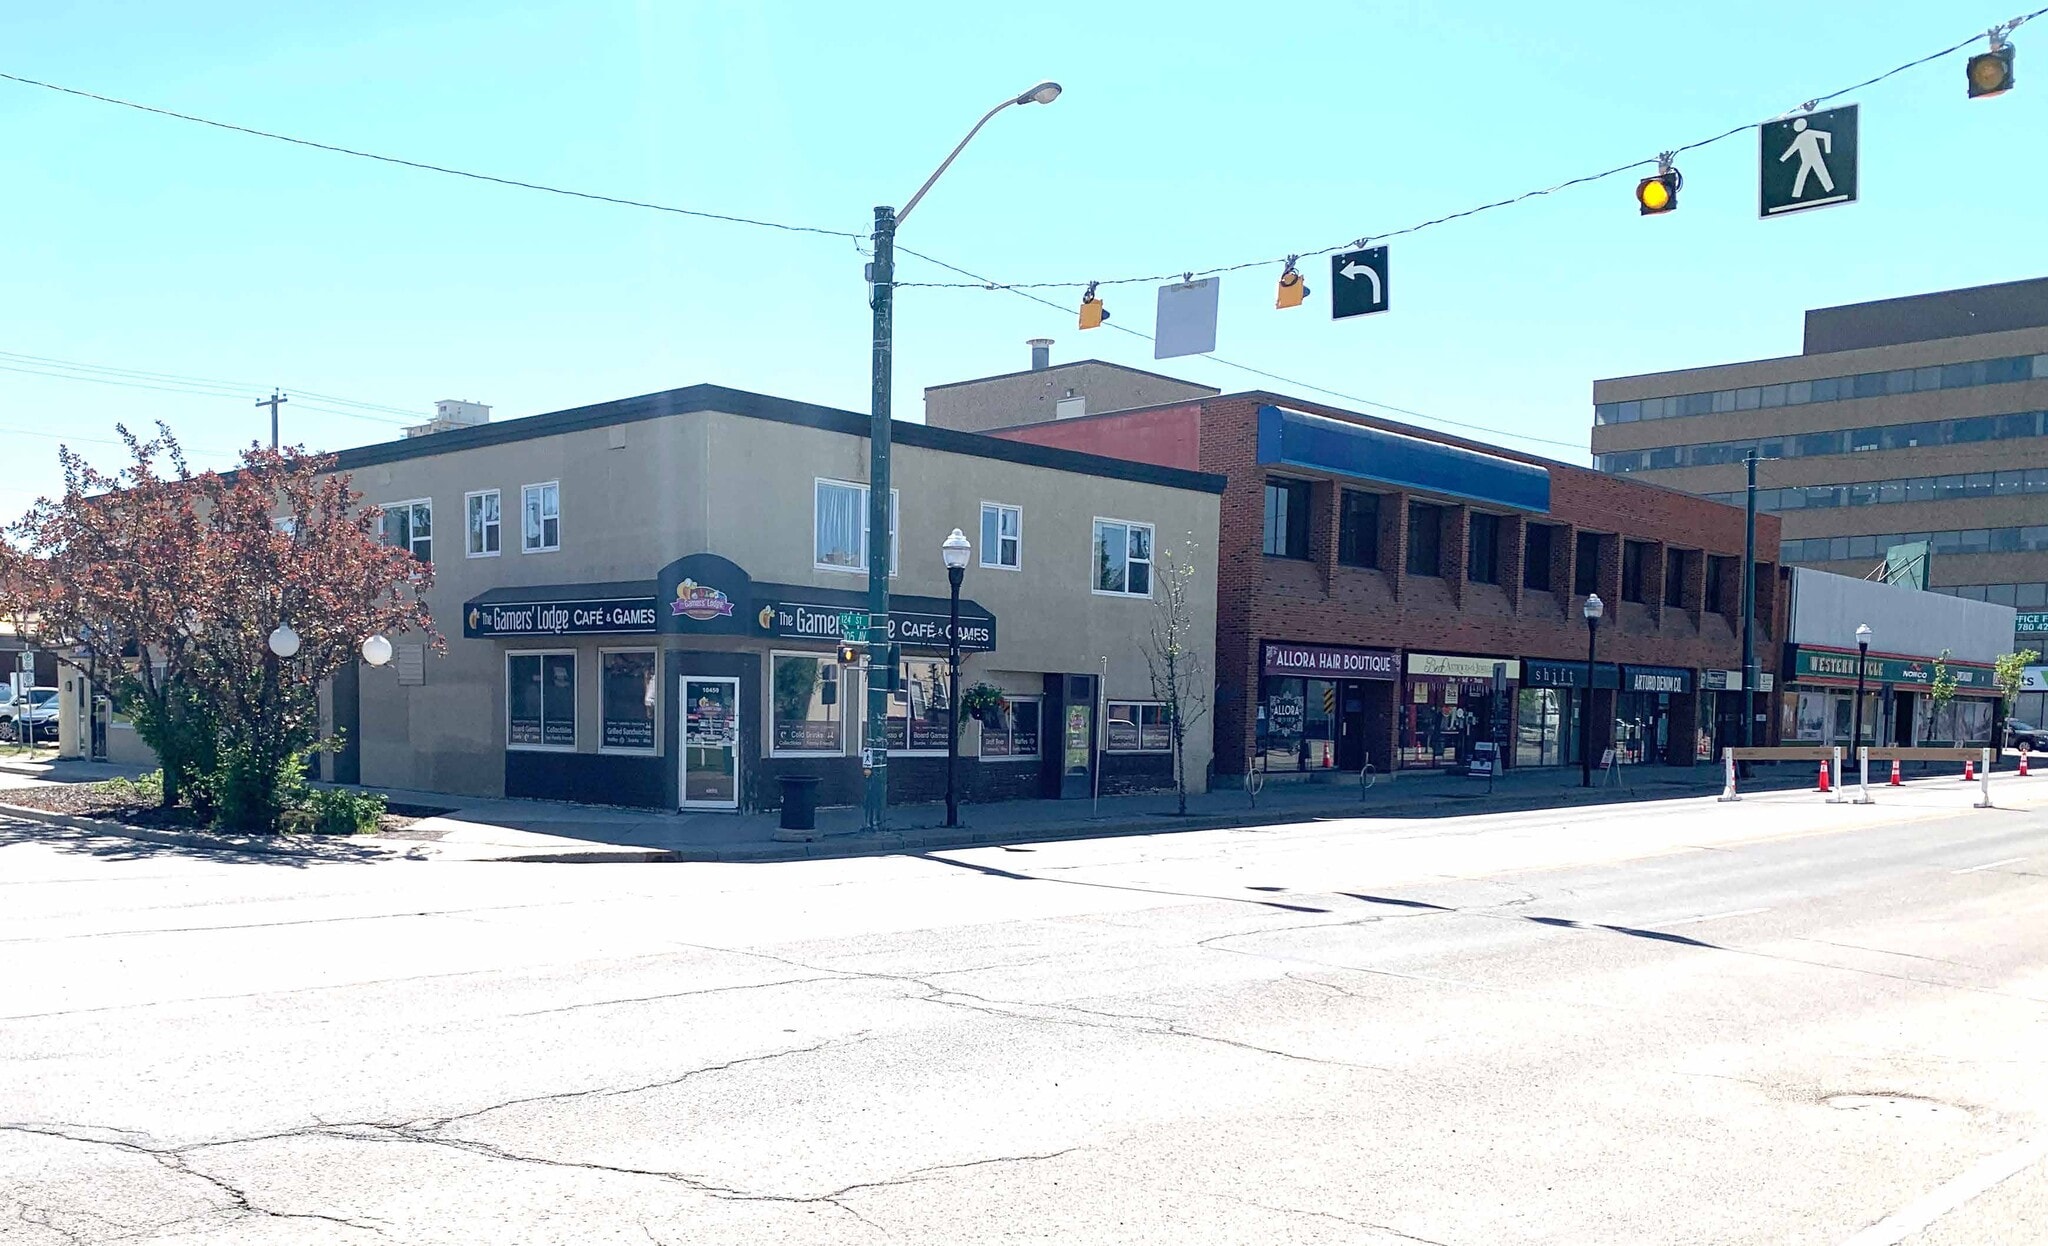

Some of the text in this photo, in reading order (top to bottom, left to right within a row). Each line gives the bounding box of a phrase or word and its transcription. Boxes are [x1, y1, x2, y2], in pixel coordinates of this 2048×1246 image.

[482, 604, 656, 634] The Gamers' Lodge CAFÉ & GAMES
[779, 611, 793, 627] The
[841, 614, 863, 625] 124 ST
[2017, 623, 2035, 631] 780
[901, 620, 935, 639] CAFÉ
[937, 626, 943, 636] &
[1276, 650, 1391, 672] ALLORA HAIR BOUTIQUE
[1809, 656, 1854, 674] WESTERN
[1535, 667, 1574, 685] shift
[1634, 674, 1657, 691] ARTURO
[1657, 675, 1673, 692] DENIM
[1273, 704, 1300, 716] ALLORA
[791, 731, 824, 739] Cold Drinks
